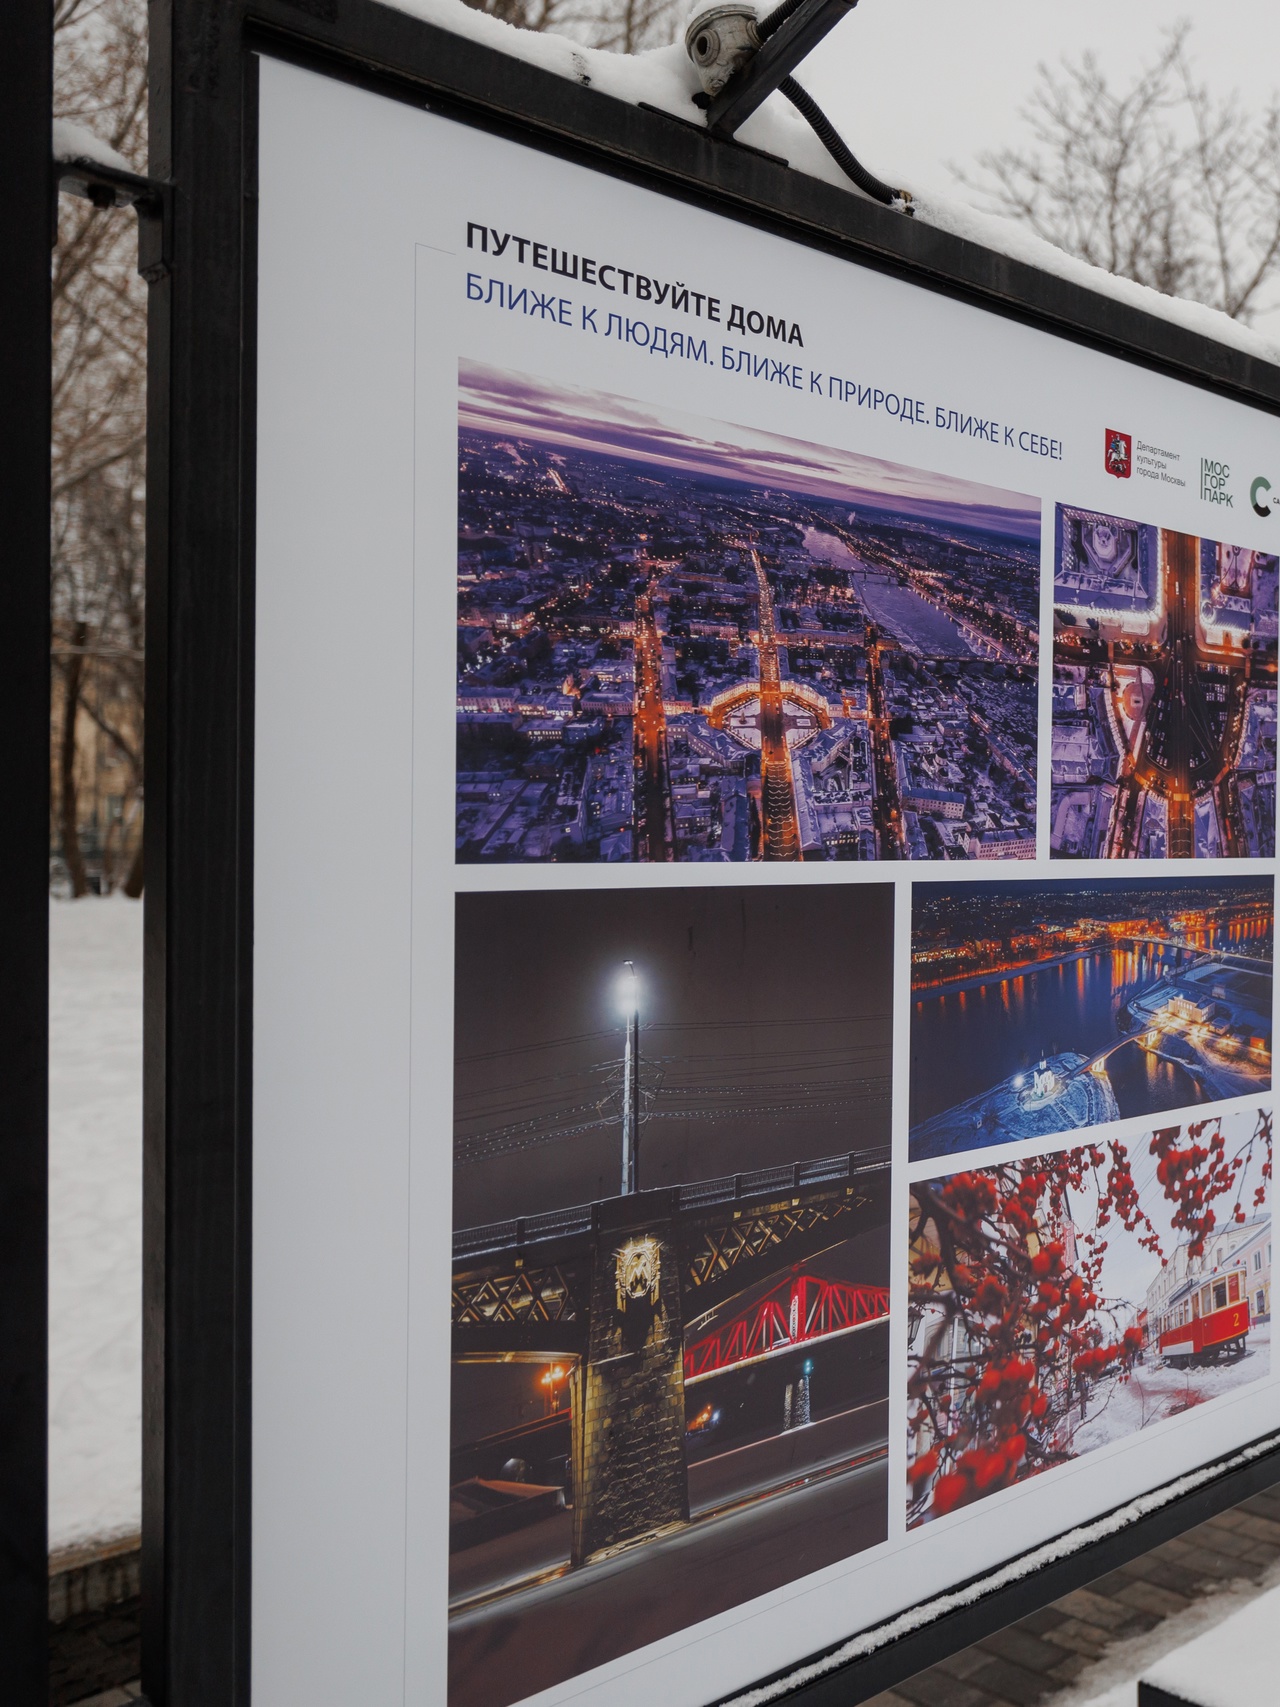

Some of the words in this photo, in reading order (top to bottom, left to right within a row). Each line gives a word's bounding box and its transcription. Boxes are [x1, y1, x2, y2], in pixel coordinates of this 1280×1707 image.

[466, 221, 721, 323] ПУТЕШЕСТВУЙТЕ
[727, 304, 804, 347] ДОМА
[466, 272, 573, 327] БЛИЖЕ
[581, 305, 598, 333] К
[604, 313, 714, 366] ЛЮДЯМ.
[721, 346, 803, 390] БЛИЖЕ
[810, 371, 822, 395] К
[829, 376, 930, 425] ПРИРОДЕ.
[935, 407, 999, 443] БЛИЖЕ
[1004, 426, 1014, 448] К
[1018, 431, 1063, 461] СЕБЕ!
[1136, 440, 1180, 461] Департамент
[1136, 454, 1167, 469] культуры
[1204, 458, 1230, 478] МОС
[1136, 466, 1160, 480] города
[1161, 472, 1186, 487] Москвы
[1204, 473, 1226, 490] ГОР
[1204, 488, 1233, 508] ПАРК
[1233, 1313, 1239, 1327] 2
